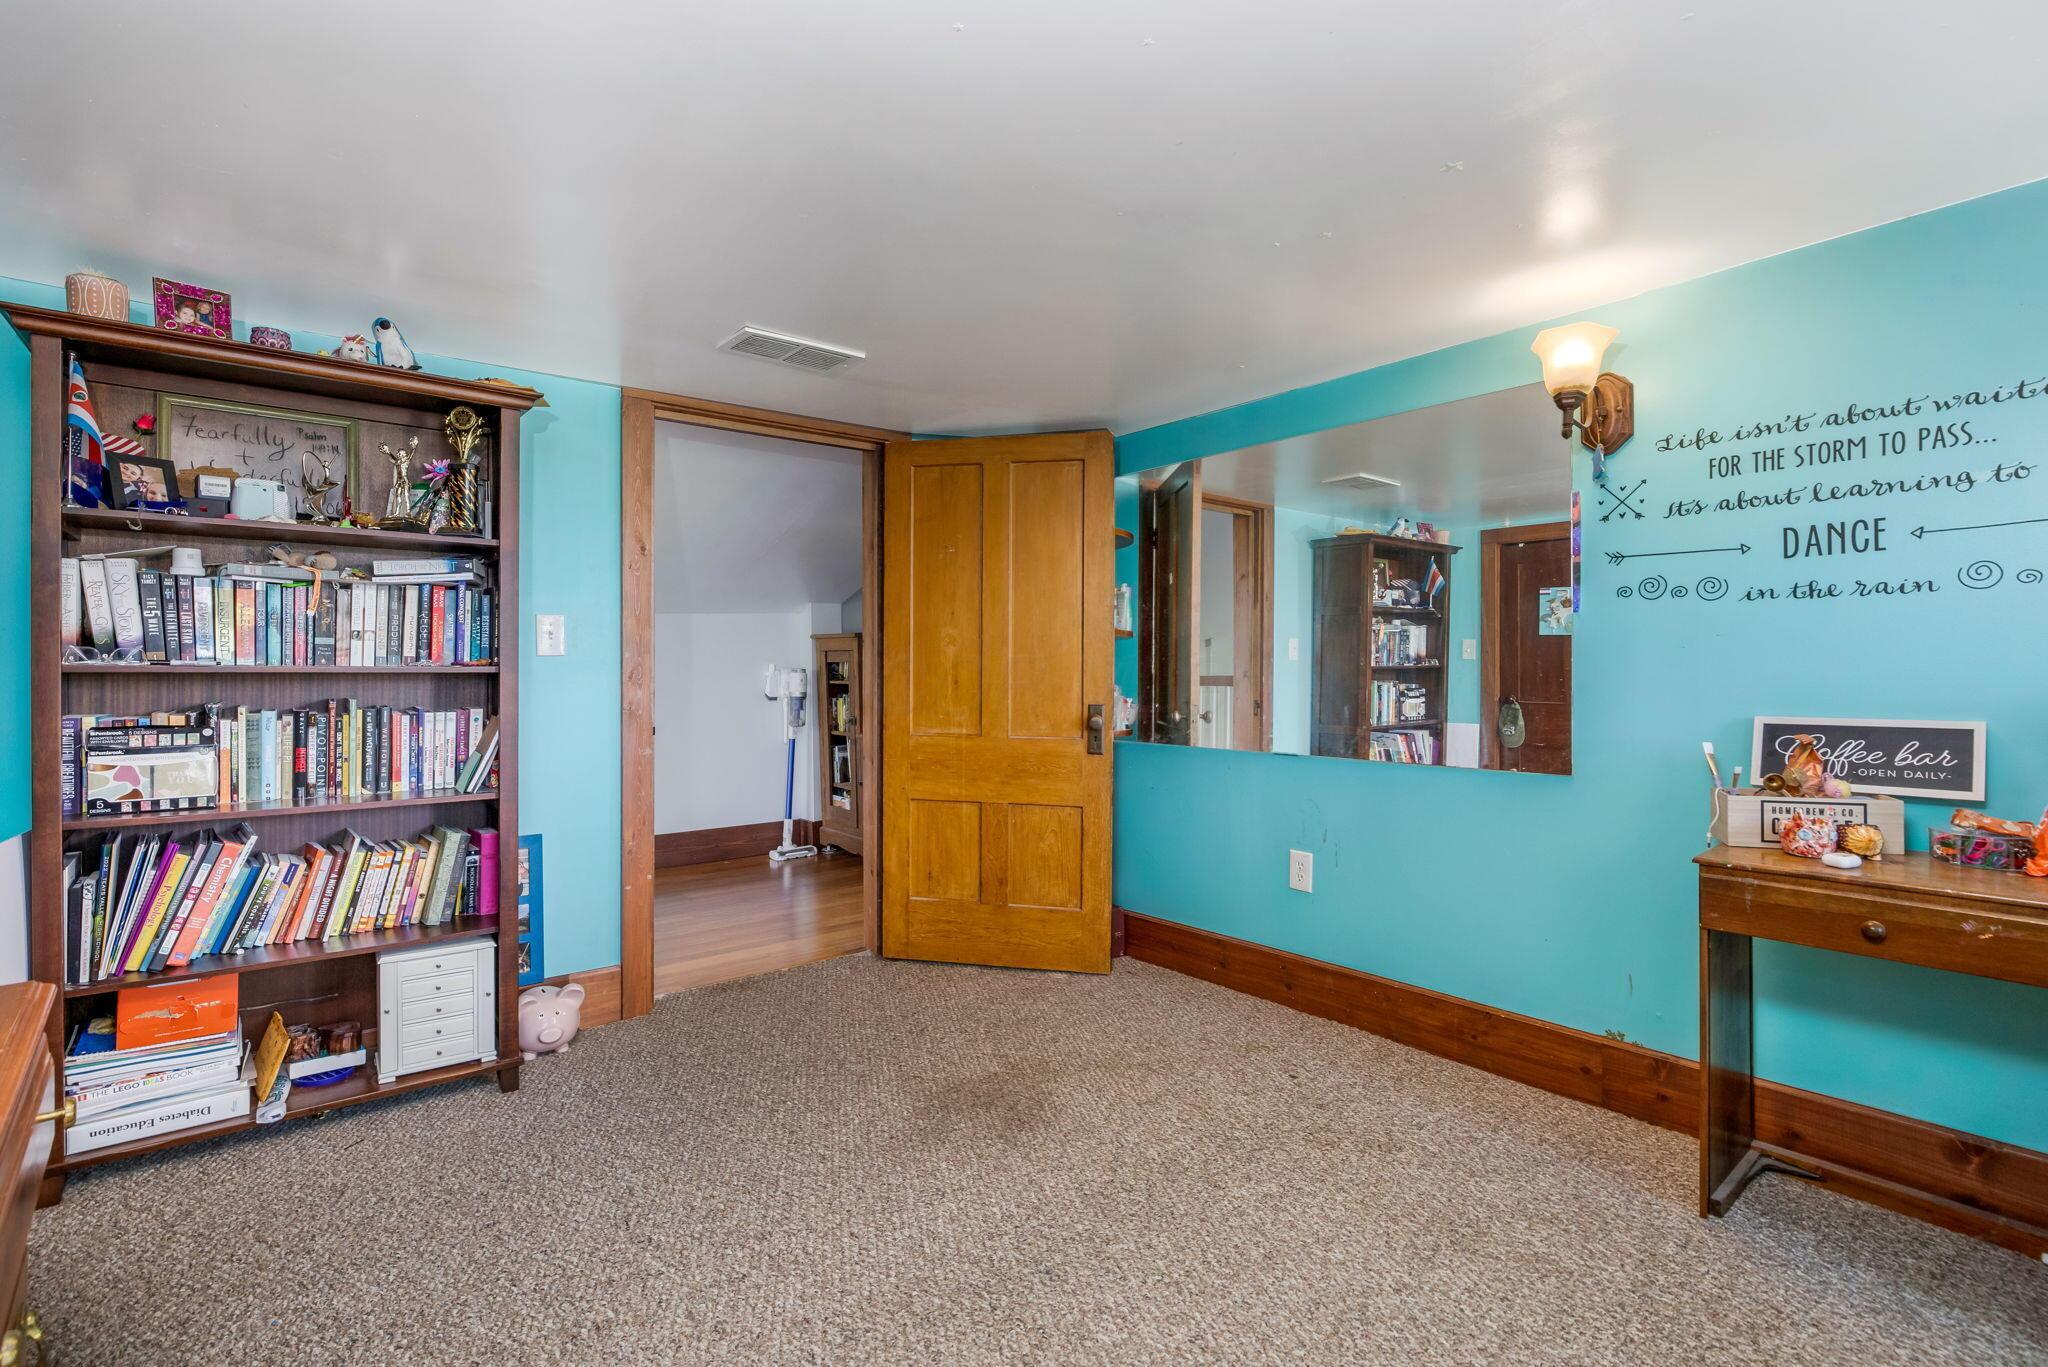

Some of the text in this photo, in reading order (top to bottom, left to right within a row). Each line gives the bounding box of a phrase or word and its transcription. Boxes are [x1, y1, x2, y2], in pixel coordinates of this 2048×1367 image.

[295, 427, 327, 441] Psalm
[1655, 428, 1723, 453] Life
[1728, 412, 1817, 442] isn't
[1820, 396, 1929, 428] about
[1709, 421, 1998, 479] FOR THE STORM TO PASS...
[1713, 488, 1807, 513] about
[1811, 470, 1978, 503] learning
[1988, 463, 2038, 484] to
[1781, 517, 1887, 559] DANCE
[110, 573, 131, 598] SKY
[1738, 577, 1941, 602] in the rain
[146, 598, 156, 608] THE
[115, 607, 137, 645] STORM
[148, 619, 159, 636] WAVE
[166, 610, 178, 641] INFINITE
[181, 611, 192, 627] LAST
[219, 602, 229, 653] INSURGENT
[182, 628, 192, 644] STAR
[317, 717, 326, 792] PIVOT POINT
[1894, 741, 1958, 766] bar
[381, 767, 386, 777] ME
[96, 801, 104, 809] 5
[201, 857, 232, 904] Chemistry
[325, 878, 338, 899] NIGHT
[145, 885, 172, 928] Psychology
[248, 904, 259, 920] GOAT
[316, 897, 332, 923] DIVIDED
[94, 934, 102, 962] SCHOOL
[90, 1070, 193, 1098] THE LEGO IDEAS BOOK
[89, 1106, 211, 1138] Diabetes Education
